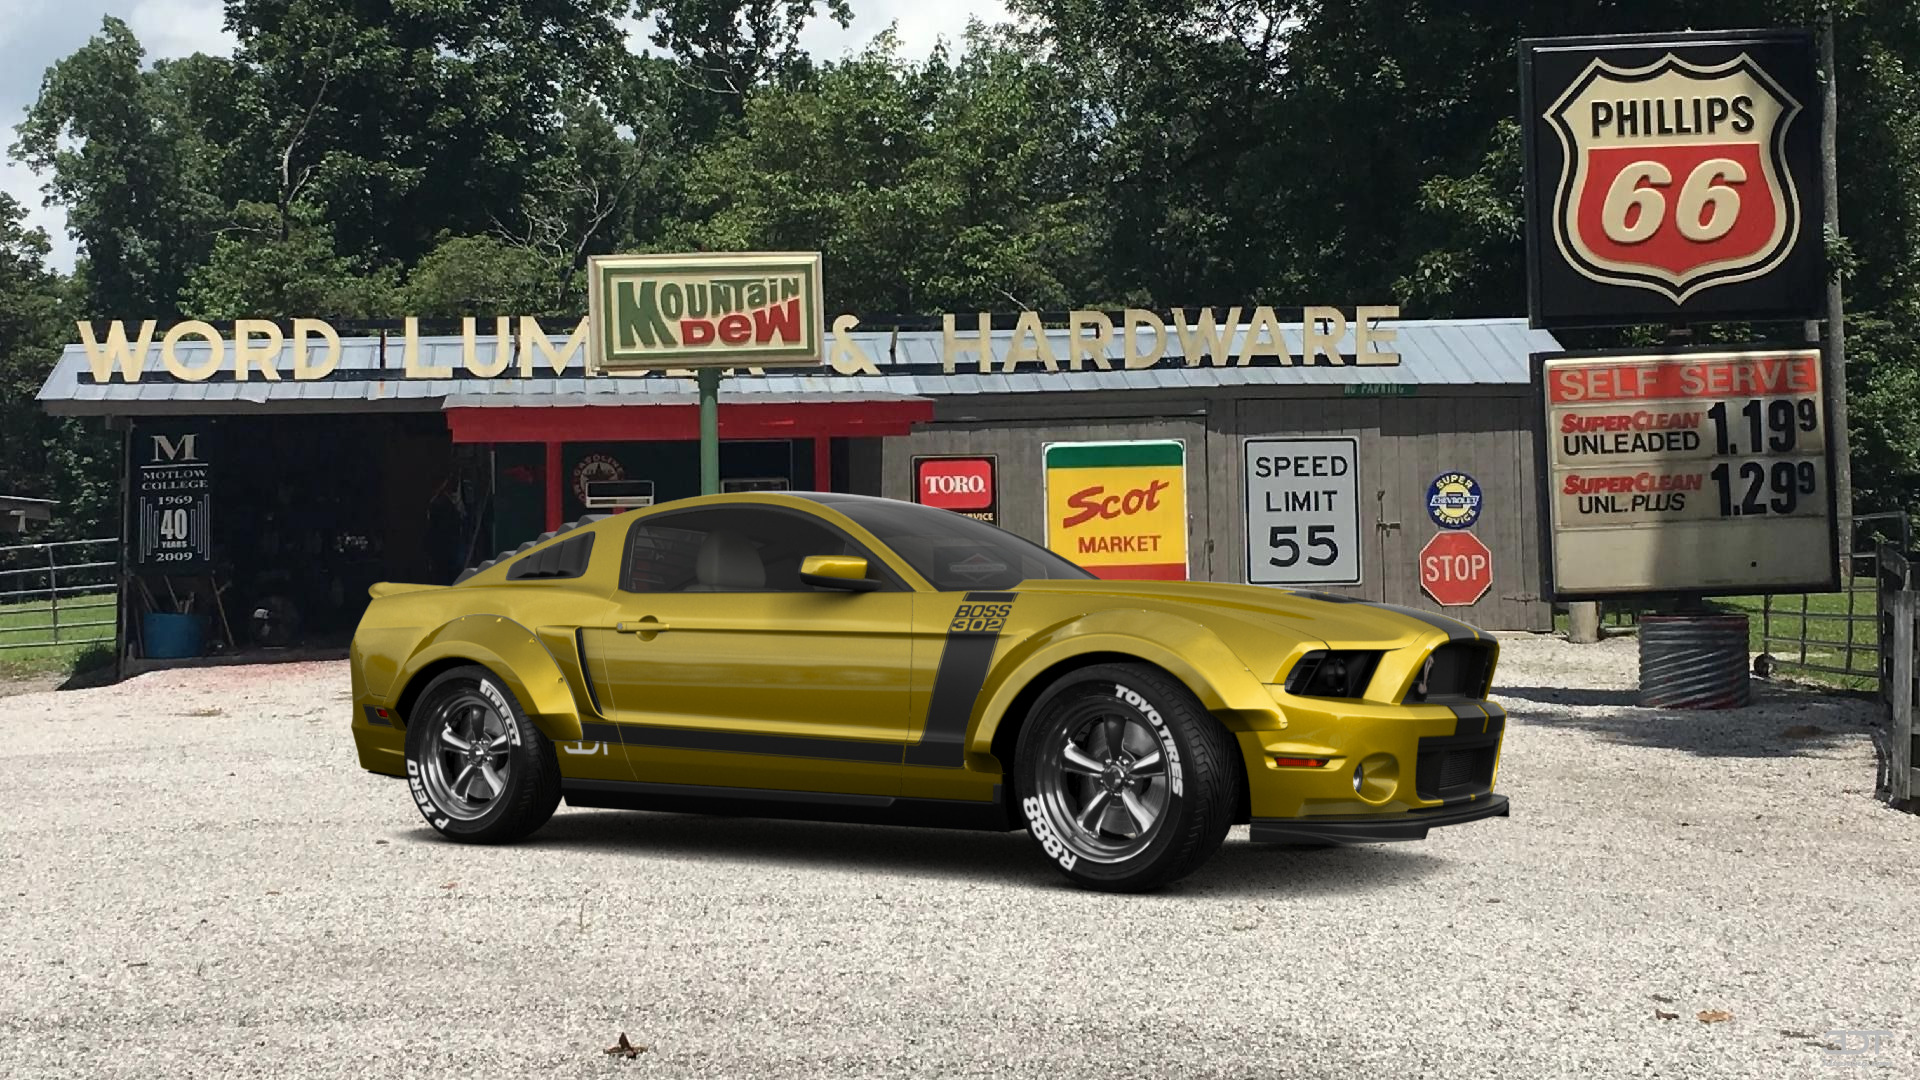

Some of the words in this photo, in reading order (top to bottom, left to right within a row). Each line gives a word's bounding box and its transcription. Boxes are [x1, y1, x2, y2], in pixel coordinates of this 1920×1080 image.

[1591, 95, 1756, 138] PHILLIPS
[1601, 158, 1748, 245] 66
[76, 317, 342, 383] WORD
[830, 314, 882, 375] &
[942, 305, 1401, 375] HARDWARE
[1559, 366, 1659, 400] SELF
[1679, 360, 1810, 394] SERVE
[151, 433, 199, 462] M
[1563, 431, 1701, 456] UNLEADED
[143, 469, 208, 480] MOTLOW
[1255, 455, 1348, 478] SPEED
[142, 480, 209, 491] COLLEGE
[1436, 474, 1474, 490] SUPER
[158, 495, 193, 505] 1969
[1063, 480, 1169, 529] Scot
[1266, 490, 1338, 512] LIMIT
[1432, 496, 1477, 505] CHEVROLET
[160, 508, 188, 540] 40
[1433, 508, 1477, 524] SERVICE
[156, 552, 193, 562] 2009
[1078, 535, 1162, 554] MARKET
[1269, 525, 1339, 568] 55
[1425, 554, 1486, 582] STOP
[954, 604, 1012, 618] BOSS
[951, 618, 1003, 632] 302
[479, 678, 521, 746] PIRELLI
[1115, 683, 1163, 727] TOYO
[1158, 725, 1184, 798] TIRES
[406, 759, 437, 818] ZERO
[1023, 796, 1078, 872] R888
